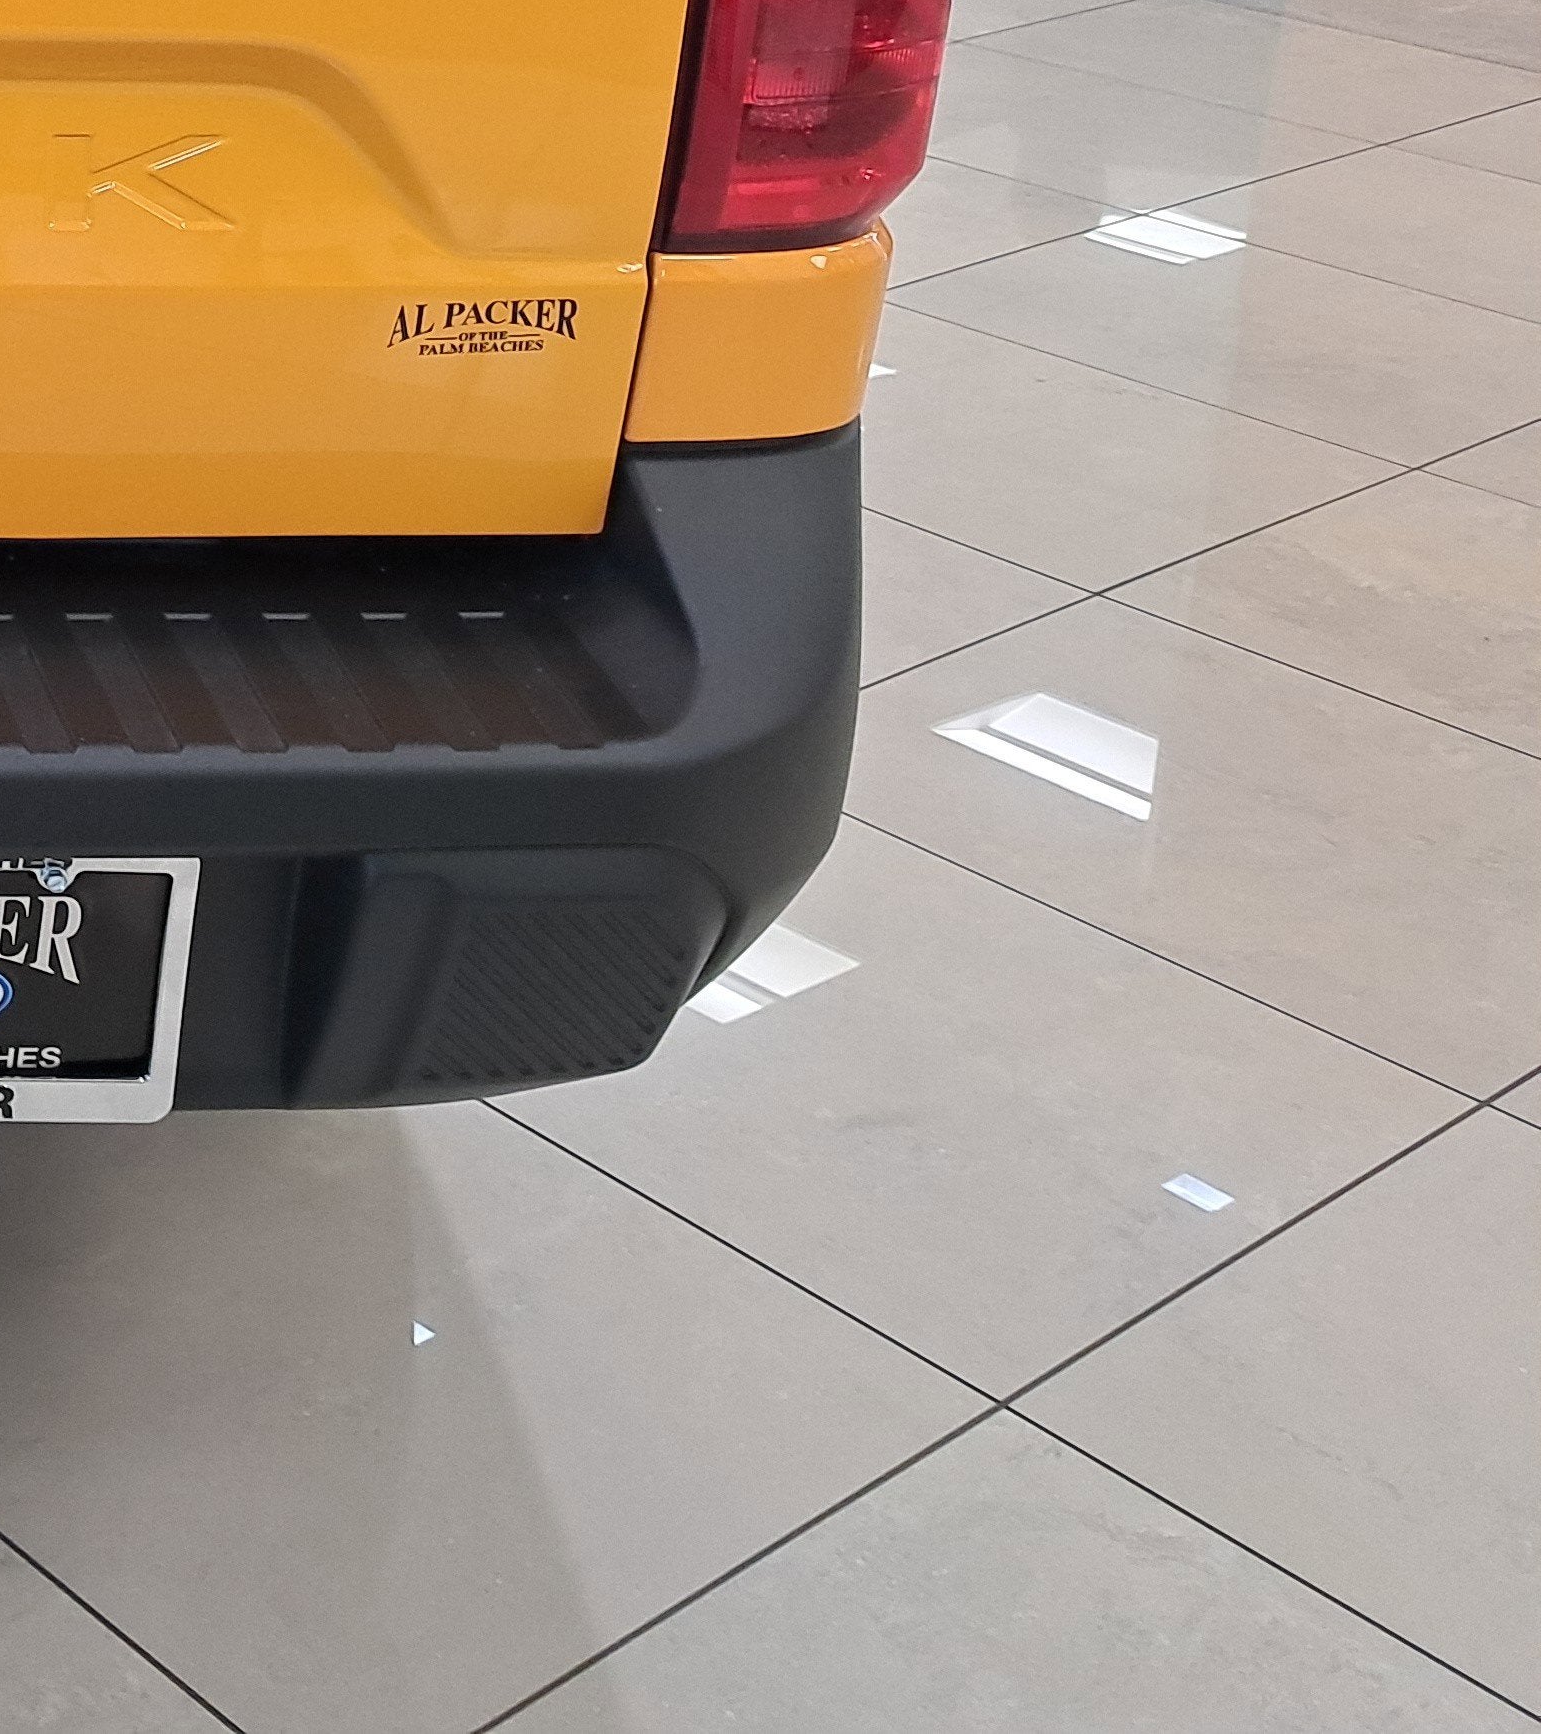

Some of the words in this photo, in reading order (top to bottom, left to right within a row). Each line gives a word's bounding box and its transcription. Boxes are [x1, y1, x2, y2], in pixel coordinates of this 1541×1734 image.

[387, 303, 434, 348] AL
[443, 298, 577, 340] PACKER
[458, 332, 477, 342] OF
[479, 331, 508, 341] THE
[418, 343, 464, 356] PALM
[468, 340, 544, 354] BEACHES
